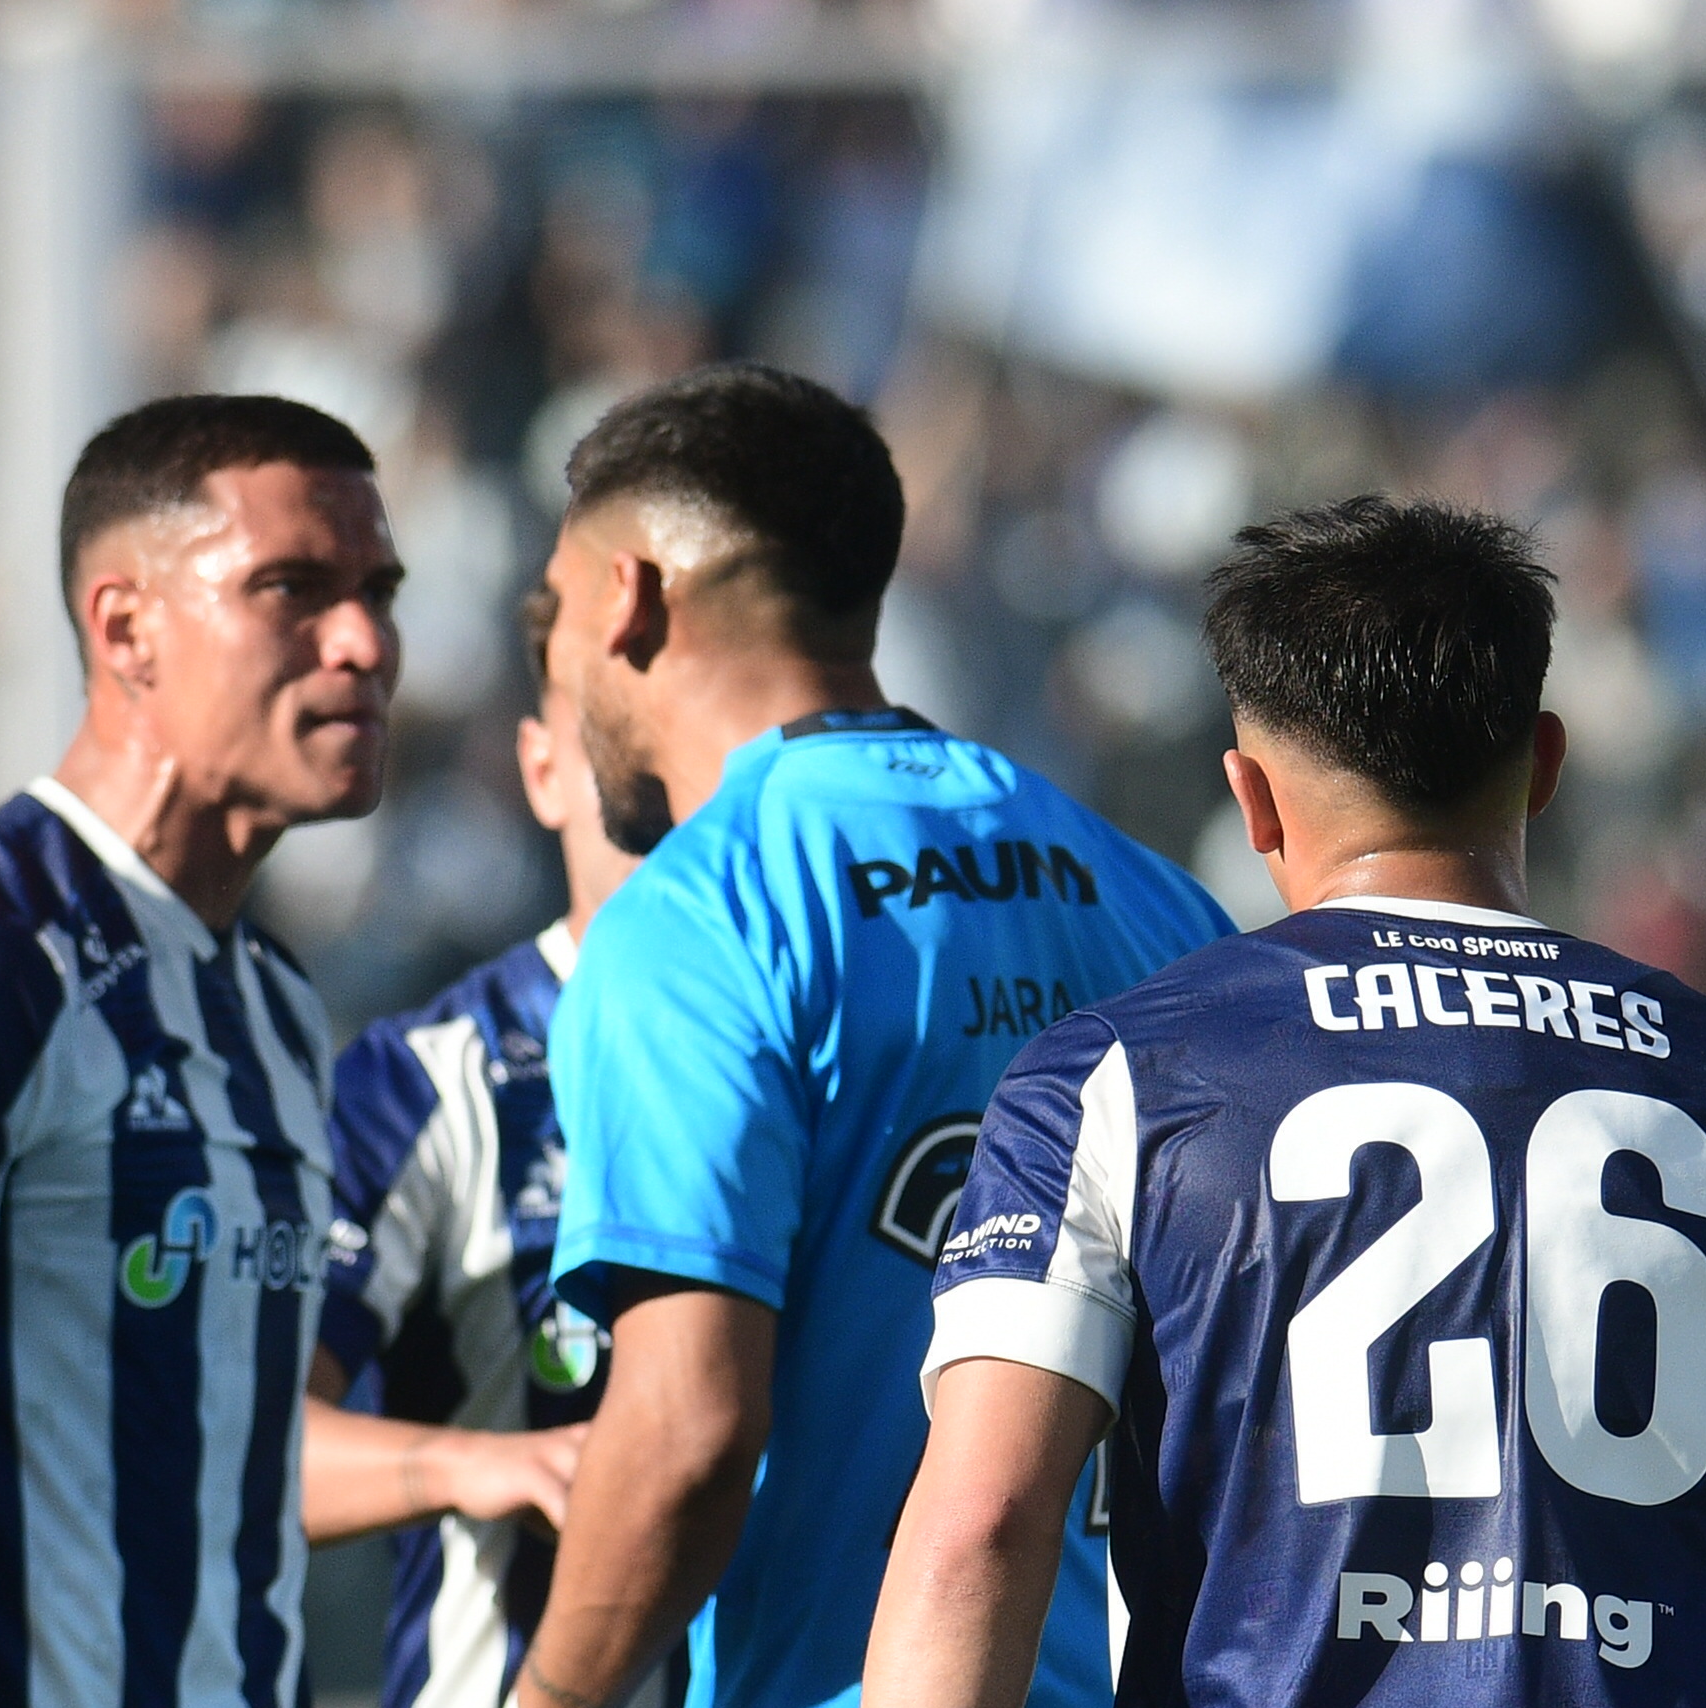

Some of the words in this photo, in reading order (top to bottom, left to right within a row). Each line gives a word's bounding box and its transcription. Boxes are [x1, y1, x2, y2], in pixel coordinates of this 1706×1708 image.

[1372, 930, 1404, 947] LE
[1461, 936, 1561, 960] SPORTIF
[1303, 962, 1672, 1060] CACERES
[938, 1238, 1033, 1264] ROTECTION
[943, 1213, 1042, 1251] AWIND
[1337, 1556, 1654, 1669] Riiing
